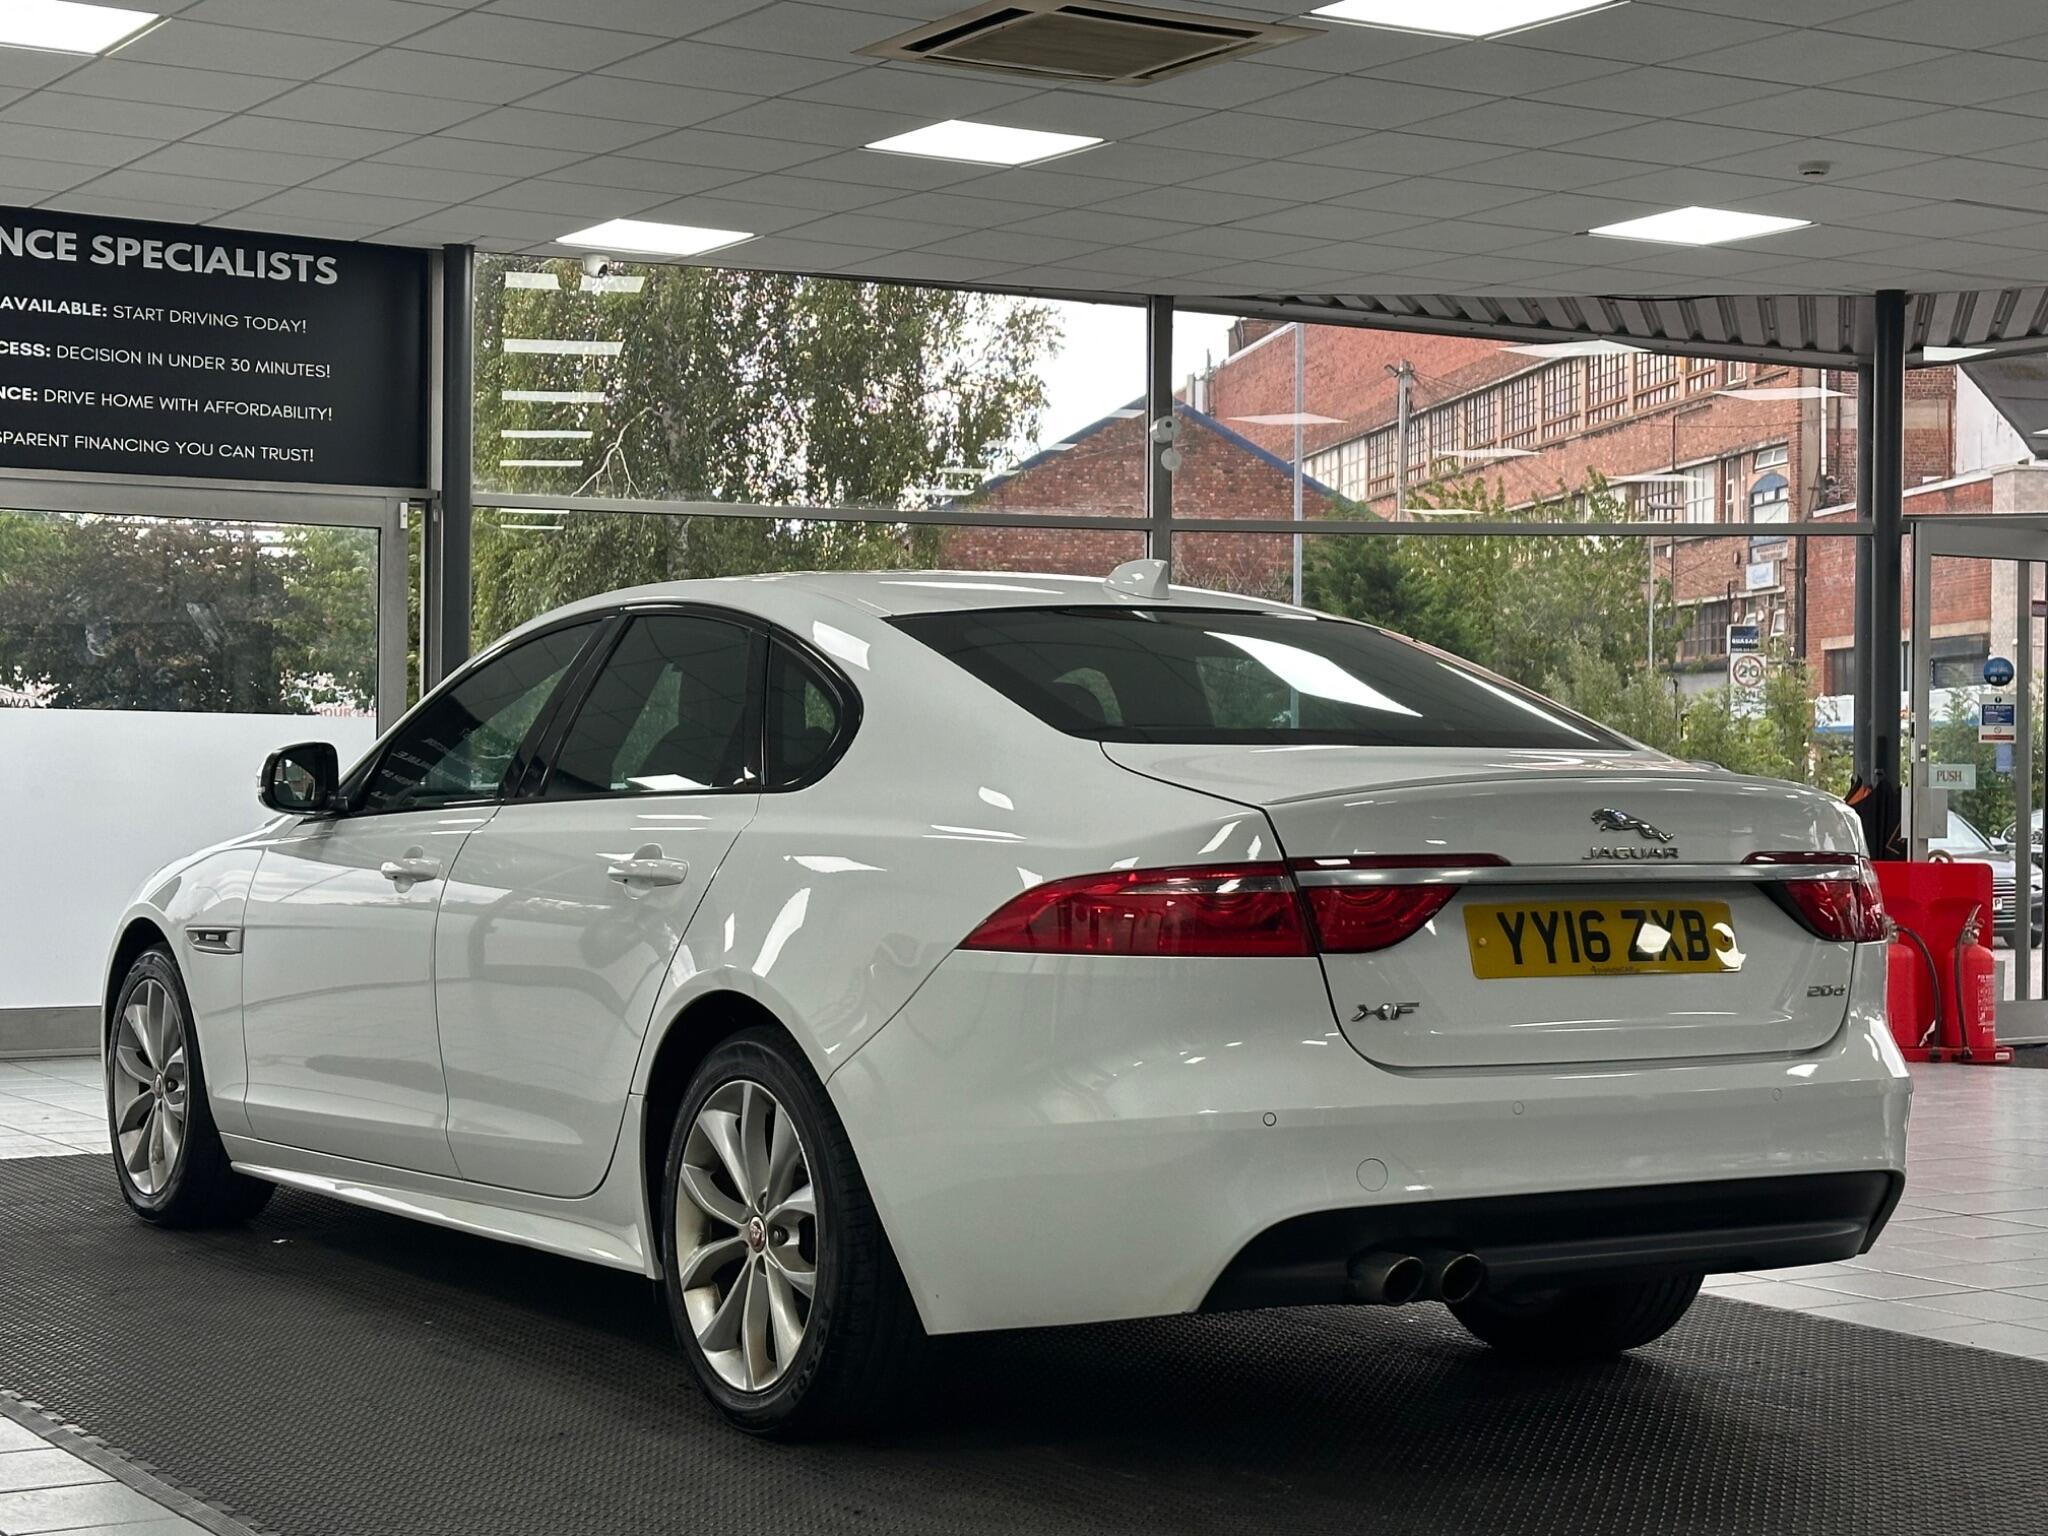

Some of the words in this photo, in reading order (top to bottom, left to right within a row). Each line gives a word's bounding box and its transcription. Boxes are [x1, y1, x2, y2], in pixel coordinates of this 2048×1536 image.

[0, 226, 77, 262] NCE
[90, 235, 338, 285] SPECIALISTS
[0, 296, 107, 317] AVAILABLE:
[113, 305, 165, 321] START
[170, 310, 239, 328] DRIVING
[244, 316, 306, 334] TODAY!
[57, 345, 142, 364] DECISION
[147, 352, 162, 366] IN
[169, 354, 225, 371] UNDER
[231, 358, 250, 372] 30
[255, 360, 330, 378] MINUTES!
[44, 389, 95, 405] DRIVE
[101, 393, 154, 410] HOME
[159, 397, 199, 412] WITH
[204, 400, 332, 421] AFFORDABILITY!
[0, 431, 69, 448] PARENT
[75, 435, 170, 454] FINANCING
[175, 442, 213, 457] YOU
[219, 444, 255, 459] CAN
[260, 447, 314, 463] TRUST!
[1738, 665, 1759, 678] 20
[1936, 770, 1962, 782] PUSH
[1582, 846, 1679, 860] JAGUAR
[1496, 910, 1611, 965] YY16
[1620, 909, 1711, 962] ZXB
[1807, 984, 1846, 997] 20d
[1350, 1002, 1420, 1022] XF
